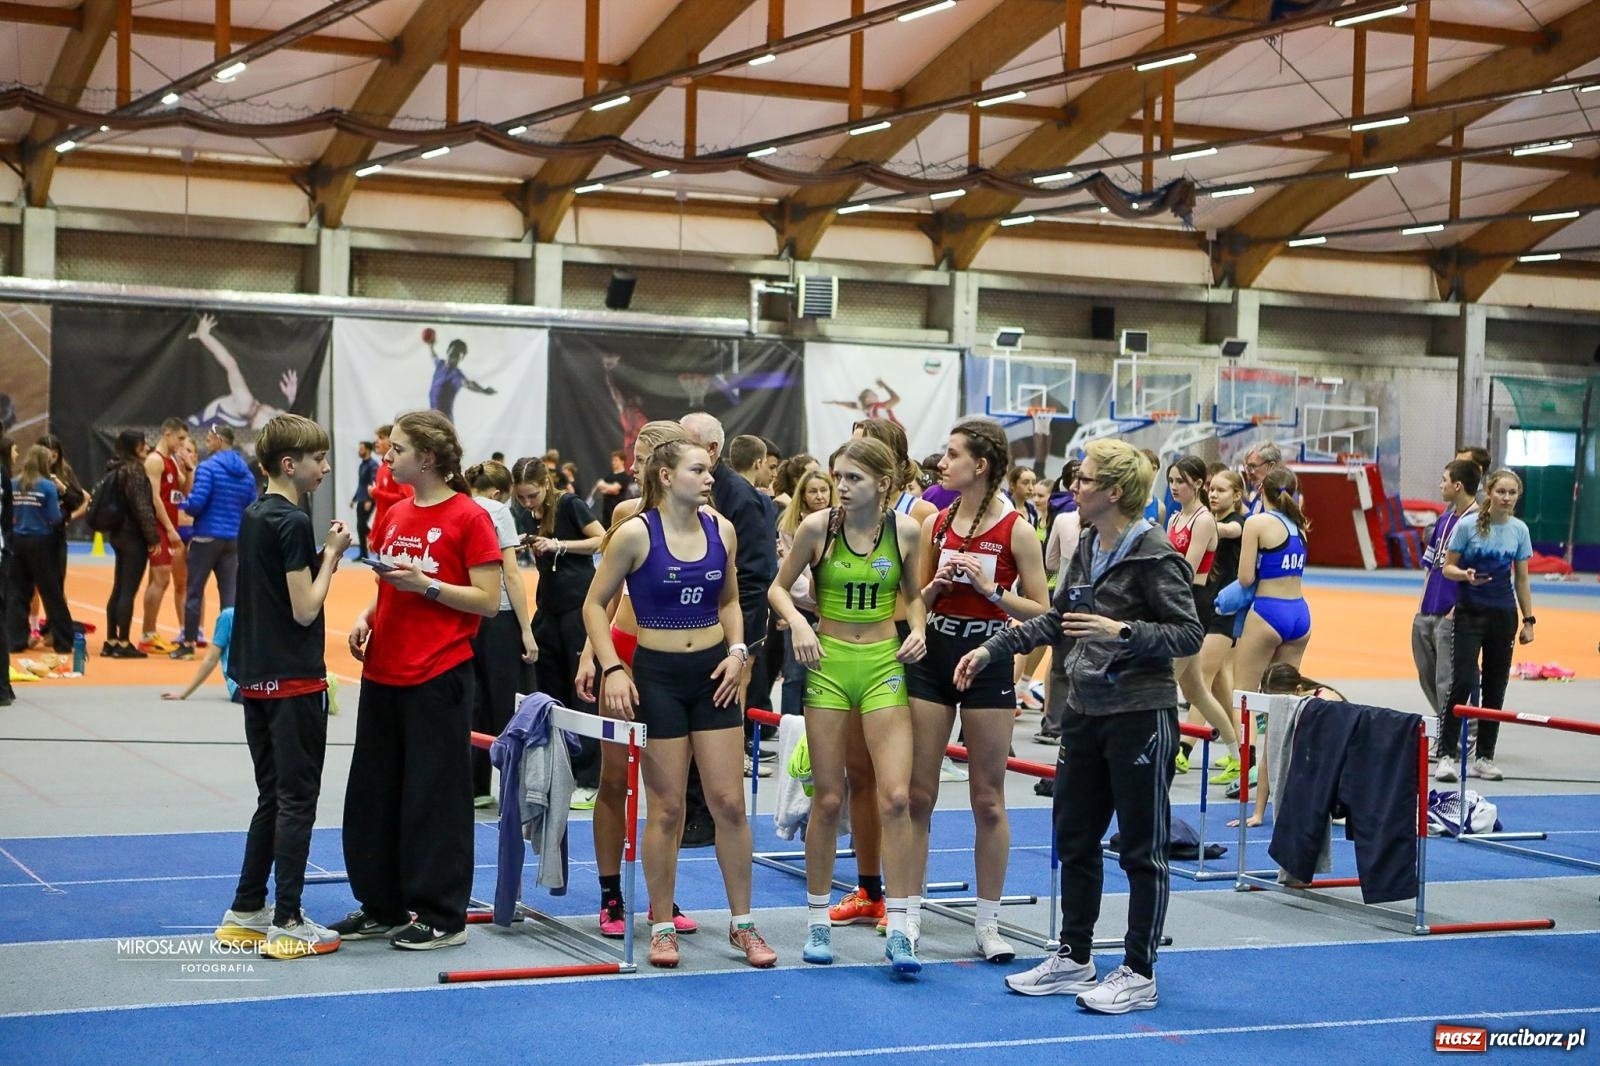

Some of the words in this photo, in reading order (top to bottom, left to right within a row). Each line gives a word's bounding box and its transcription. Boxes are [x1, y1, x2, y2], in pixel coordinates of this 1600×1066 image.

[1281, 553, 1304, 570] 404
[680, 586, 704, 605] 66
[843, 582, 880, 610] 111
[962, 619, 1011, 638] PR
